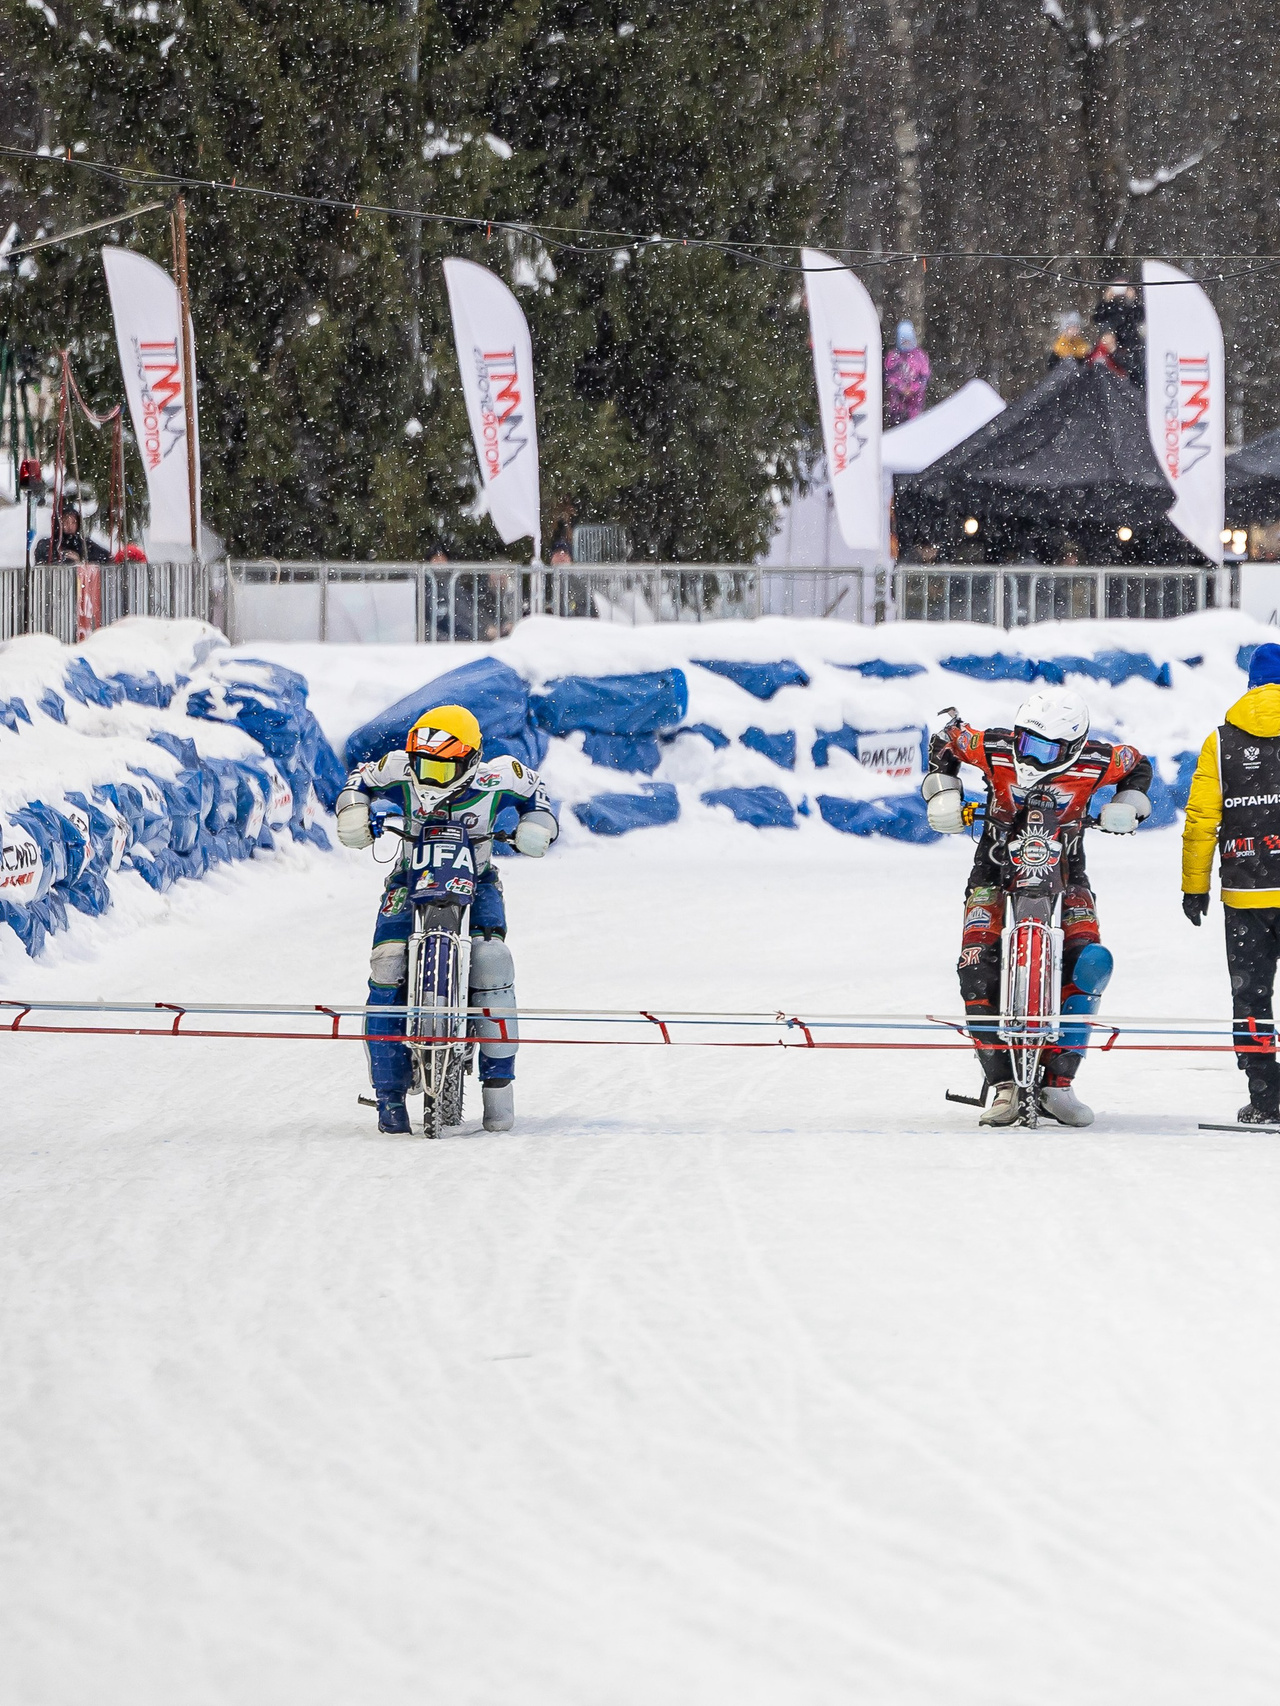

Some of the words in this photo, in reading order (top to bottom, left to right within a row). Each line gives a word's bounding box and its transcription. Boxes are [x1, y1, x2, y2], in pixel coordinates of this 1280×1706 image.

[0, 841, 38, 872] СМО
[412, 843, 475, 875] UFA
[1224, 837, 1255, 853] MMT
